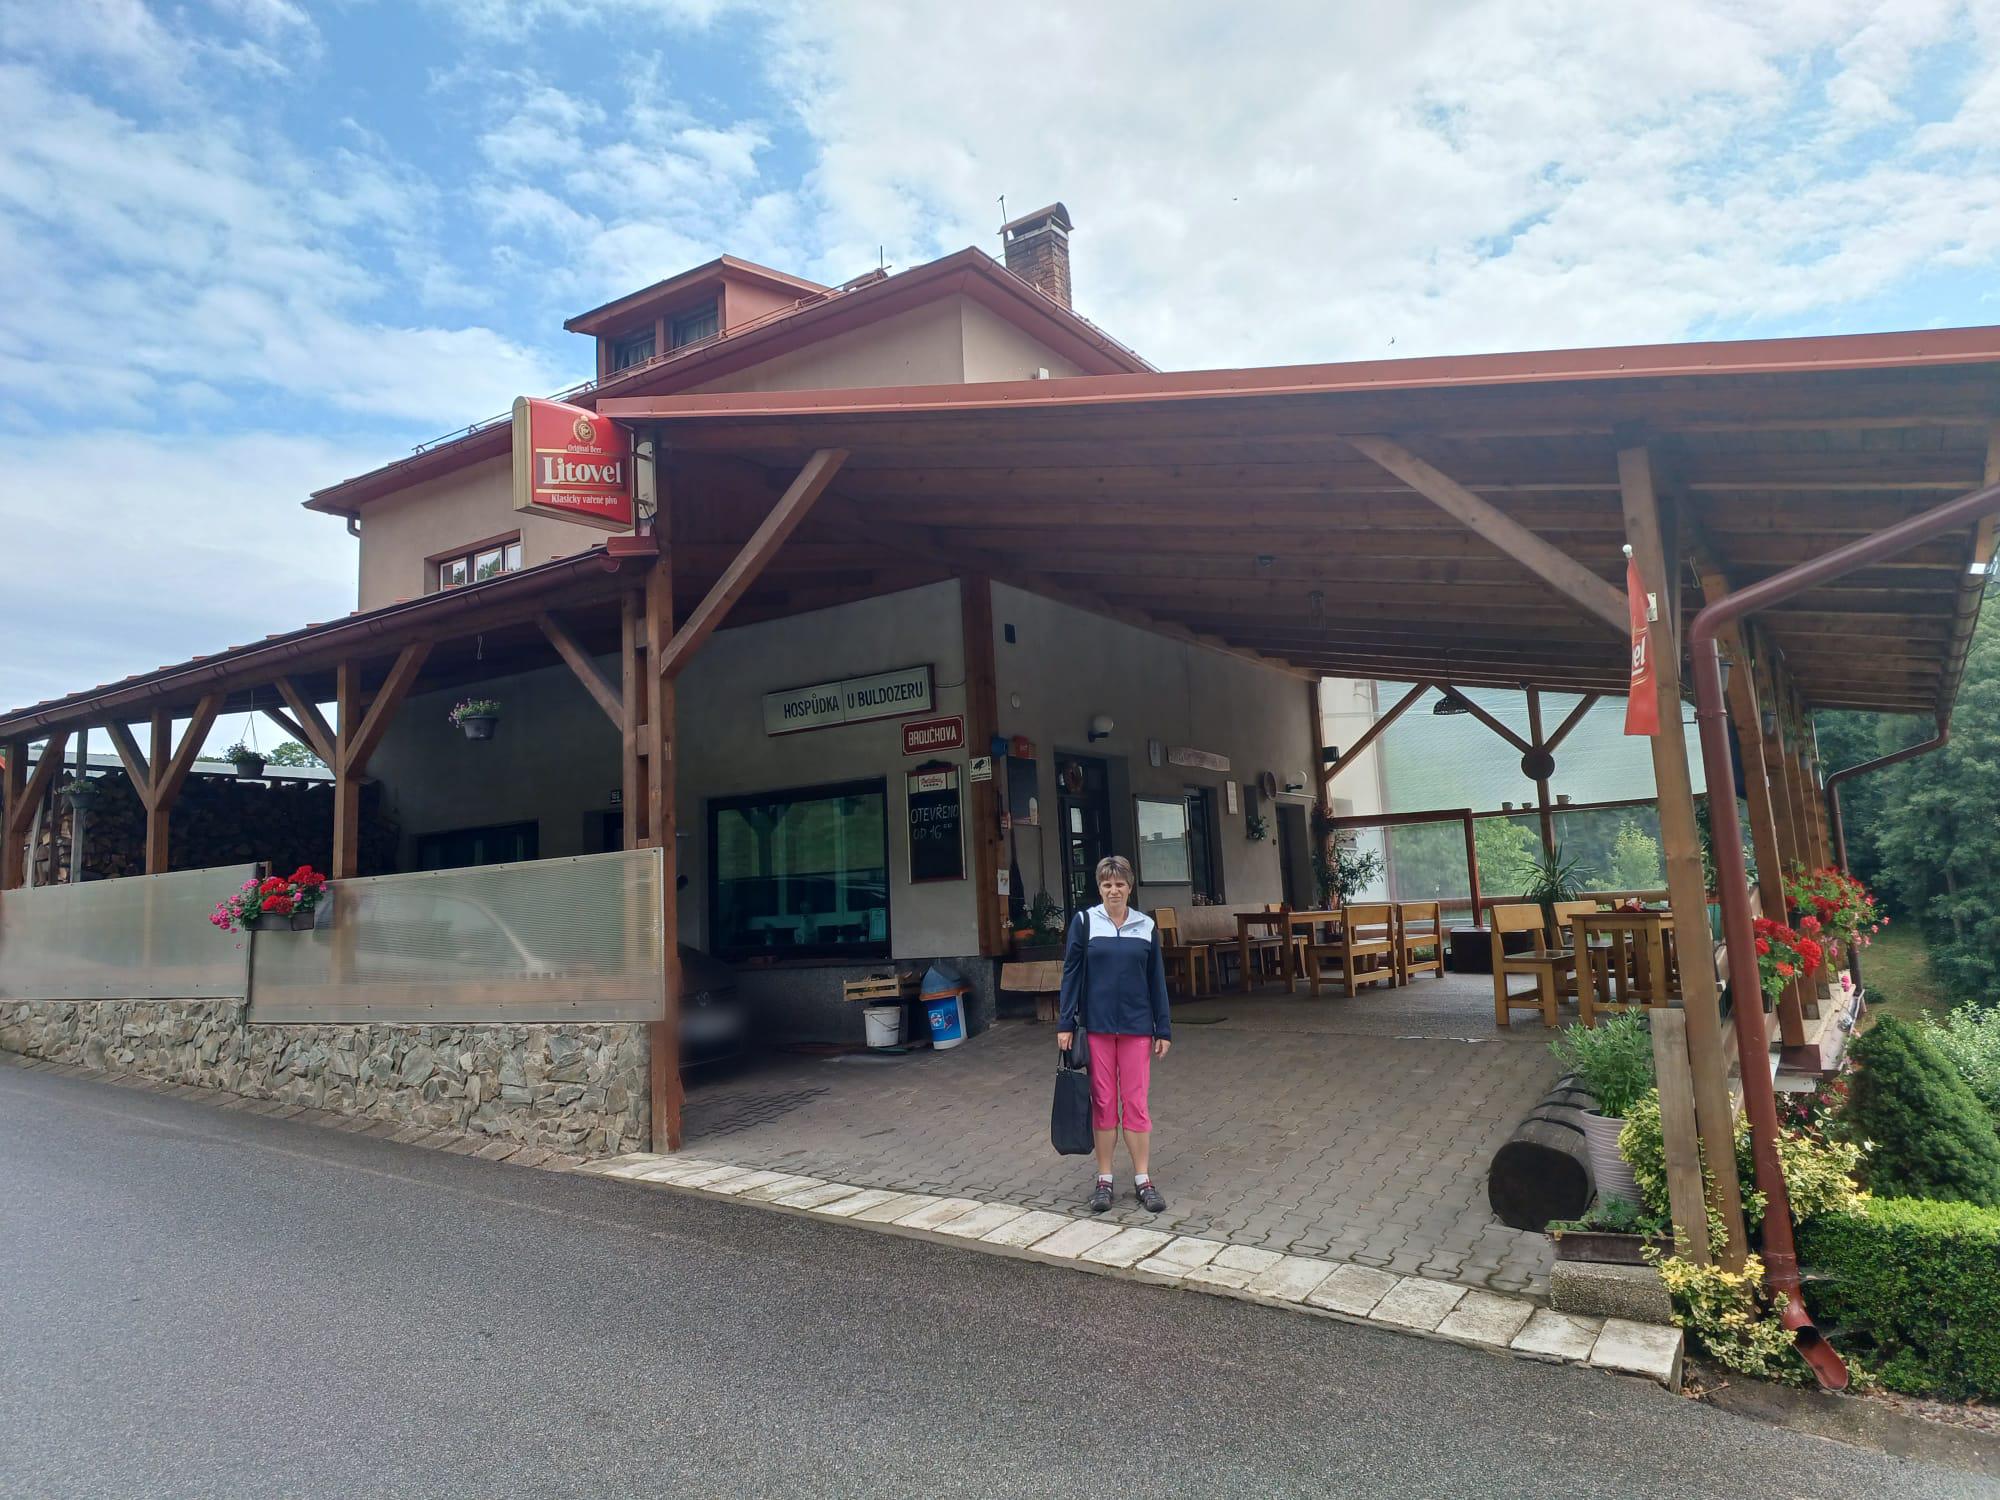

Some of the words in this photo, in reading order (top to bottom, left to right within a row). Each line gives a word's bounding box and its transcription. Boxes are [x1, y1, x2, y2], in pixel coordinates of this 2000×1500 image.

[544, 457, 621, 484] Litovel
[552, 493, 581, 504] Klasicky
[605, 496, 617, 506] pivo
[784, 693, 840, 719] HOSPŮDKA
[847, 693, 855, 709] U
[858, 681, 924, 708] BULDOZERU
